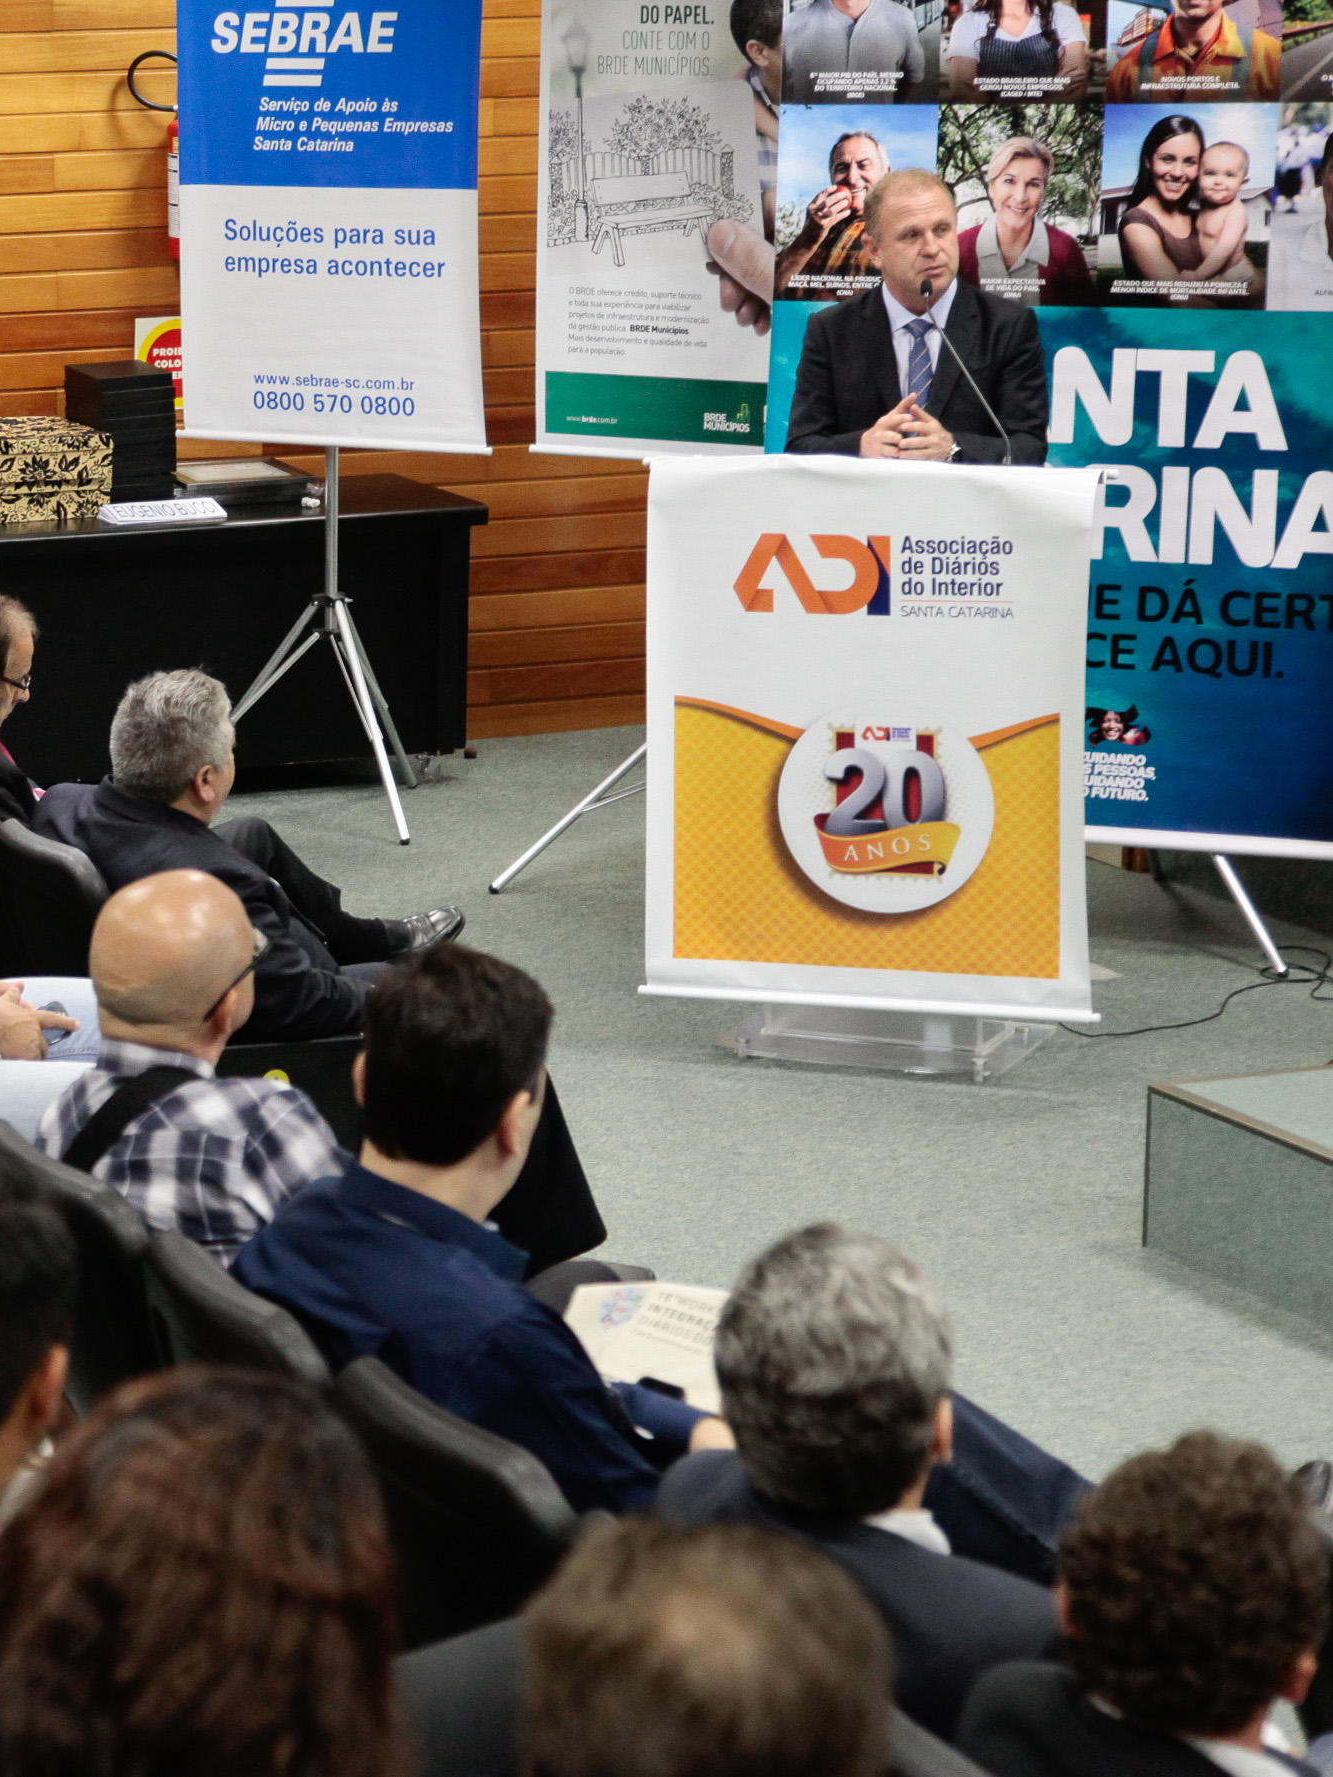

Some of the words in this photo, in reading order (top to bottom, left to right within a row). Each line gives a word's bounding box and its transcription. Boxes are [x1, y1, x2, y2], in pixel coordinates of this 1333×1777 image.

[640, 5, 659, 24] DO
[664, 5, 715, 25] PAPEL.
[211, 12, 398, 54] SEBRAE
[622, 30, 663, 50] CONTE
[668, 31, 697, 50] COM
[701, 31, 710, 50] O
[597, 55, 629, 75] BRDE
[634, 53, 714, 77] MUNICÍPIOS.
[259, 97, 310, 115] Serviço
[313, 98, 331, 112] de
[335, 98, 377, 115] Apoio
[382, 98, 398, 112] às
[255, 117, 295, 131] Micro
[299, 121, 308, 131] e
[312, 118, 379, 135] Pequenas
[383, 118, 454, 135] Empresas
[253, 136, 292, 151] Santa
[297, 137, 354, 152] Catarina
[224, 218, 324, 248] Soluções
[334, 227, 384, 248] para
[394, 228, 436, 246] sua
[224, 255, 318, 278] empresa
[327, 257, 446, 278] acontecer
[569, 287, 575, 295] O
[575, 287, 595, 296] BRDE
[596, 288, 622, 297] oferece
[624, 288, 649, 299] crédito,
[650, 291, 676, 301] suporte
[678, 291, 702, 300] técnico
[574, 299, 588, 307] toda
[603, 301, 643, 310] experiência
[644, 303, 660, 311] para
[662, 303, 691, 312] viabilizar
[569, 311, 595, 320] projetos
[596, 311, 605, 319] de
[606, 313, 654, 322] infraestrutura
[661, 315, 710, 325] modernização
[569, 322, 576, 330] da
[578, 323, 600, 332] gestão
[630, 324, 650, 333] BRDE
[569, 333, 584, 341] Mais
[649, 338, 682, 347] qualidade
[684, 339, 692, 347] de
[693, 340, 707, 348] vida
[568, 346, 583, 354] para
[254, 374, 415, 391] www.sebrae-sc.com.br
[253, 390, 305, 411] 0800
[313, 394, 353, 414] 570
[360, 396, 415, 416] 0800
[1048, 345, 1289, 452] NTA
[703, 412, 727, 422] BRDE
[703, 421, 750, 432] MUNICÍPIOS
[112, 504, 176, 518] EUGENIO
[174, 500, 219, 516] BUCCI
[901, 535, 1013, 559] Associação
[732, 533, 891, 616] ADI
[902, 557, 924, 575] de
[932, 556, 1000, 576] Diários
[902, 576, 925, 595] do
[932, 577, 1004, 596] Interior
[1137, 578, 1204, 625] DÁ
[901, 606, 945, 618] SANTA
[948, 606, 1014, 619] CATARINA
[1150, 636, 1284, 679] AQUI.
[862, 726, 890, 741] ADI
[1093, 764, 1156, 781] PESSOAS,
[824, 747, 945, 837] 20
[1090, 786, 1149, 801] FUTURO.
[844, 834, 931, 862] ANOS
